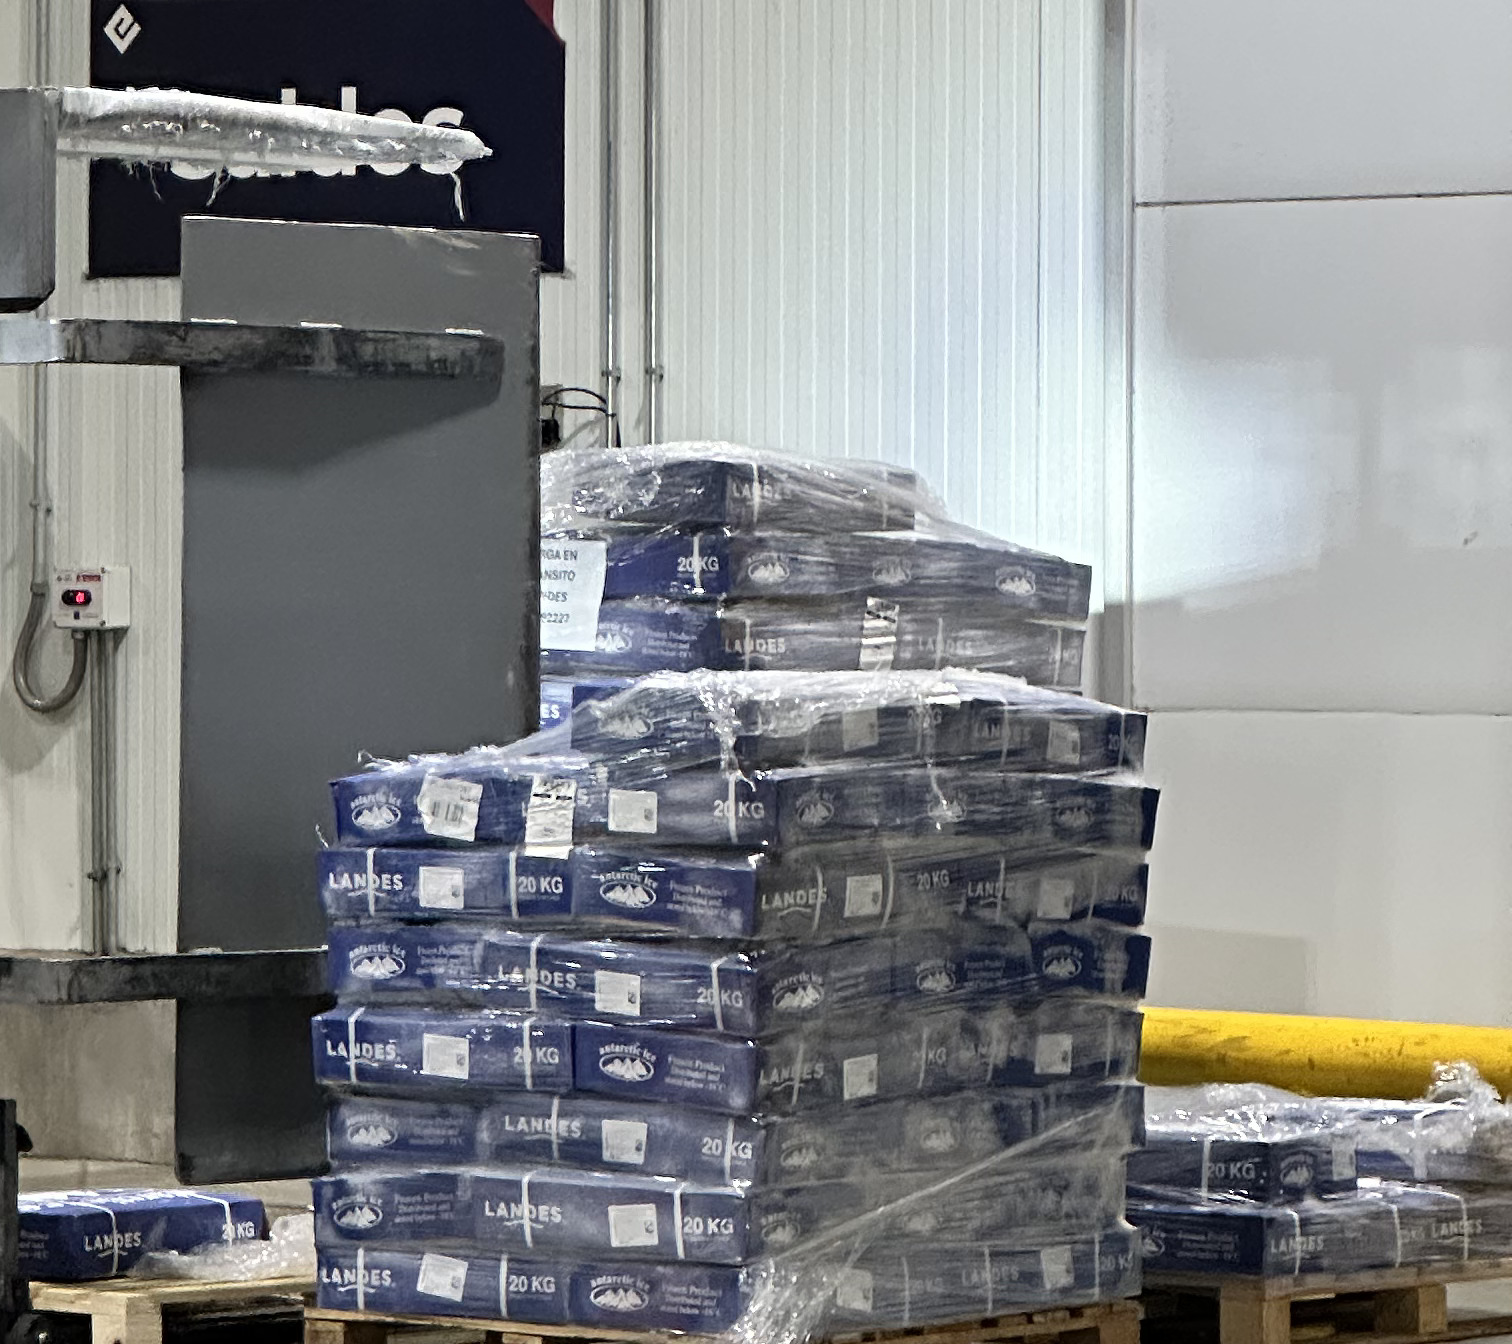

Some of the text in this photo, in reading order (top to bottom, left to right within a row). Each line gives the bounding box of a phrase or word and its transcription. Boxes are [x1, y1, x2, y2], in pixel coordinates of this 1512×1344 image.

[564, 549, 578, 561] EN
[739, 802, 765, 819] KG
[518, 876, 563, 894] 20 KG
[722, 990, 743, 1007] KG
[513, 1046, 559, 1065] 2 KG
[702, 1137, 722, 1154] 20
[1208, 1163, 1256, 1180] 20 KG
[684, 1217, 734, 1234] 20 KG
[509, 1275, 556, 1293] 20 KG
